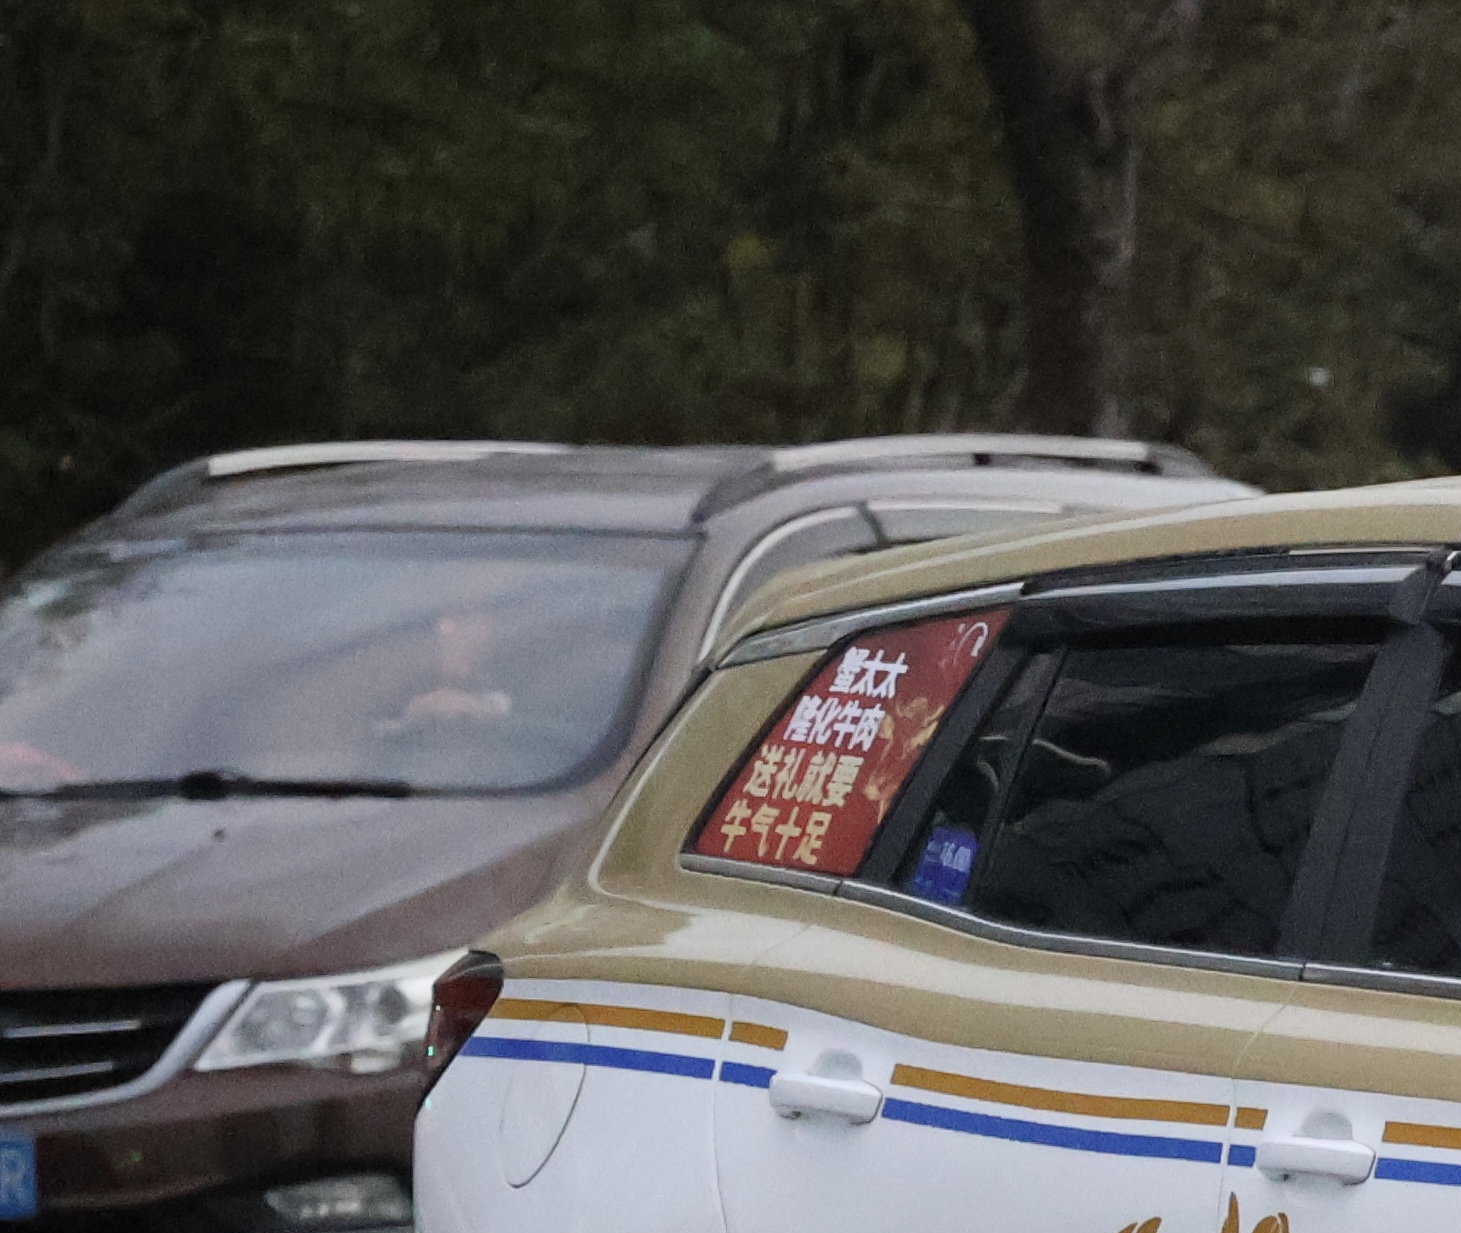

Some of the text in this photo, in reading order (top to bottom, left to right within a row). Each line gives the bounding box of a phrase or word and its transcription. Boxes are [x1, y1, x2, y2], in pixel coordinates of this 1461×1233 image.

[783, 695, 886, 752] 隆化牛肉
[744, 745, 865, 807] 送礼就要
[720, 800, 832, 865] 牛气十足
